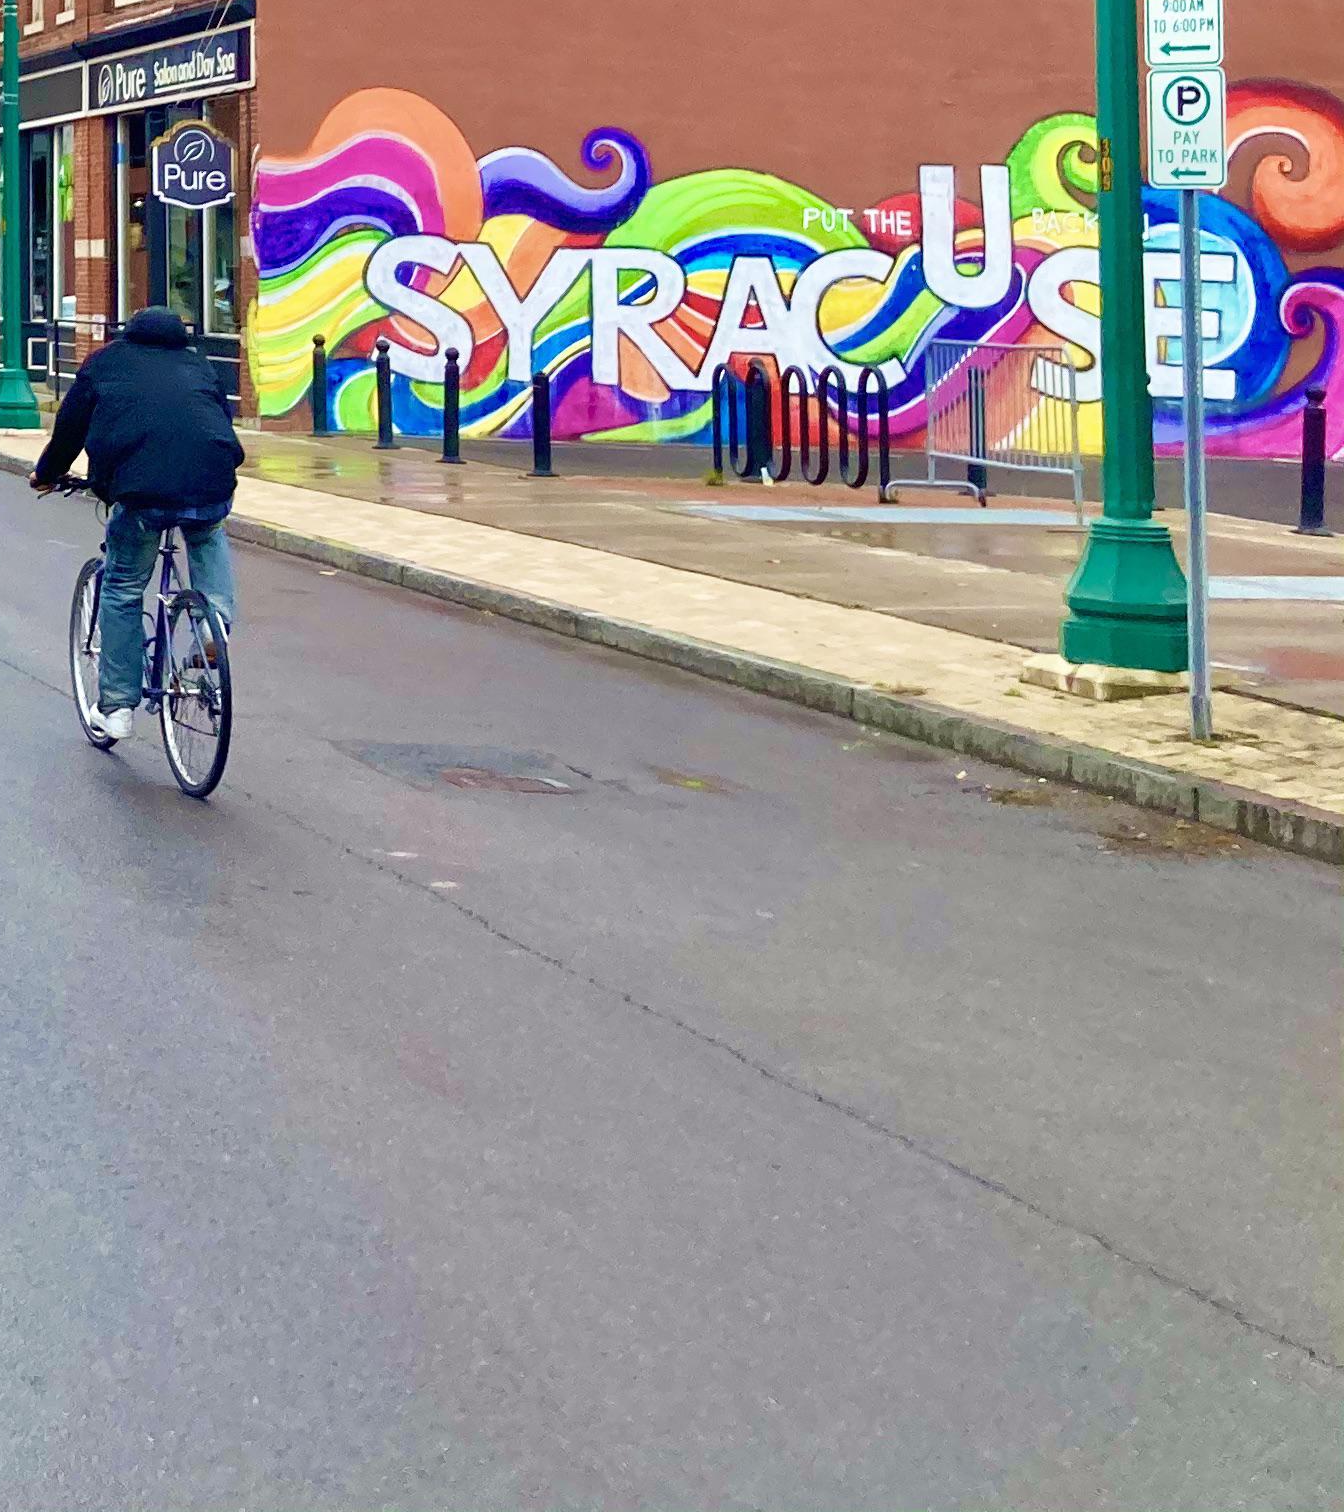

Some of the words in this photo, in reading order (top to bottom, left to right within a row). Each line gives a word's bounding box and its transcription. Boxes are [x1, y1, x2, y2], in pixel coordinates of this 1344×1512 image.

[1162, 0, 1187, 13] 9:00
[1153, 19, 1167, 33] TO
[1172, 19, 1197, 33] 6:00
[1199, 17, 1215, 31] PM
[115, 63, 147, 101] Pure
[153, 57, 178, 87] Salon
[178, 50, 196, 82] and
[196, 50, 215, 79] Day
[216, 46, 236, 76] Spa
[1177, 85, 1201, 116] P
[1173, 131, 1200, 145] PAY
[1157, 149, 1174, 163] TO
[1182, 149, 1218, 163] PARK
[164, 163, 226, 191] Pure
[802, 207, 854, 233] PUT
[863, 208, 913, 236] THE
[1030, 206, 1100, 234] BACK
